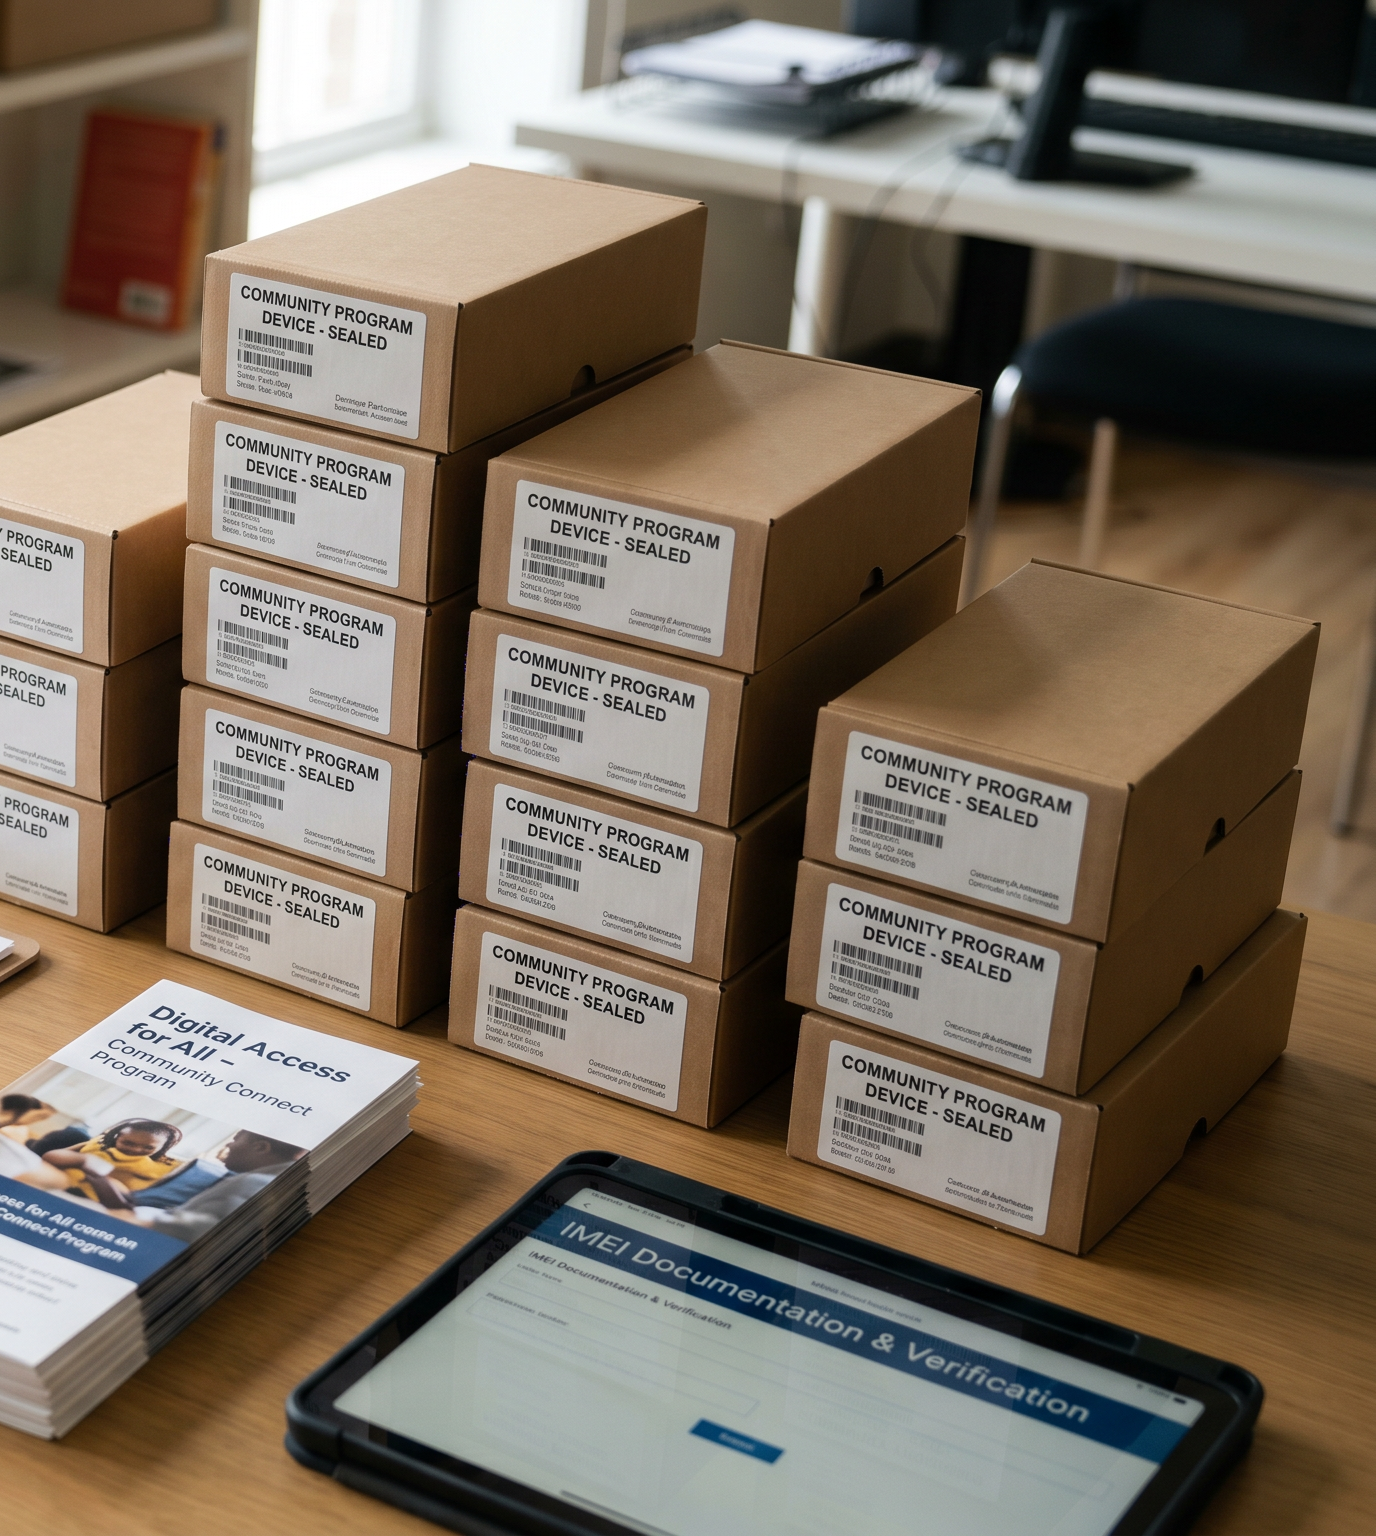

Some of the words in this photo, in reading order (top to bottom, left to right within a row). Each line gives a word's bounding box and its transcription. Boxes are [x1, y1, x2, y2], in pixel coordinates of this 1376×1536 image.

[240, 285, 331, 317] COMMUNITY
[334, 304, 413, 336] PROGRAM
[262, 310, 316, 335] DEVICE
[327, 325, 388, 351] SEALED
[225, 433, 313, 466] COMMUNITY
[316, 455, 392, 487] PROGRAM
[246, 458, 298, 484] DEVICE
[309, 474, 367, 501] SEALED
[6, 529, 74, 560] PROGRAM
[527, 493, 629, 528] COMMUNITY
[632, 516, 720, 550] PROGRAM
[550, 519, 611, 546] DEVICE
[624, 536, 691, 564] SEALED
[0, 547, 53, 572] SEALED
[219, 579, 306, 614] COMMUNITY
[309, 603, 384, 637] PROGRAM
[240, 603, 291, 631] DEVICE
[302, 621, 359, 650] SEALED
[0, 664, 67, 696] PROGRAM
[508, 647, 607, 685] COMMUNITY
[610, 673, 695, 709] PROGRAM
[530, 673, 589, 702] DEVICE
[602, 693, 667, 722] SEALED
[215, 721, 302, 757] COMMUNITY
[305, 747, 379, 782] PROGRAM
[236, 745, 287, 772] DEVICE
[298, 764, 355, 793] SEALED
[861, 745, 972, 787] COMMUNITY
[976, 775, 1072, 816] PROGRAM
[884, 773, 951, 804] DEVICE
[965, 796, 1039, 828] SEALED
[4, 796, 69, 828] PROGRAM
[505, 797, 603, 836] COMMUNITY
[606, 825, 690, 862] PROGRAM
[527, 822, 585, 852] DEVICE
[597, 844, 662, 874] SEALED
[203, 855, 288, 892] COMMUNITY
[291, 882, 364, 919] PROGRAM
[224, 880, 274, 907] DEVICE
[284, 900, 340, 929] SEALED
[839, 897, 948, 941] COMMUNITY
[951, 930, 1045, 972] PROGRAM
[862, 925, 927, 957] DEVICE
[940, 949, 1012, 983] SEALED
[492, 945, 589, 986] COMMUNITY
[592, 976, 674, 1015] PROGRAM
[514, 971, 571, 1001] DEVICE
[582, 994, 645, 1025] SEALED
[127, 1023, 171, 1045] for
[170, 1041, 217, 1061] All
[149, 1006, 245, 1047] Digital
[242, 1042, 351, 1083] Access
[90, 1051, 177, 1089] Program
[108, 1039, 223, 1087] Community
[226, 1082, 313, 1117] Connect
[841, 1054, 950, 1100] COMMUNITY
[953, 1089, 1046, 1133] PROGRAM
[865, 1082, 928, 1116] DEVICE
[942, 1108, 1013, 1143] SEALED
[25, 1204, 51, 1217] for
[50, 1214, 76, 1227] All
[56, 1232, 126, 1262] Program
[529, 1252, 557, 1265] IMEI
[558, 1262, 648, 1299] Documentation
[665, 1301, 732, 1329] Verification
[560, 1222, 630, 1256] IMEI
[630, 1247, 865, 1344] Documentation
[872, 1334, 895, 1353] &
[908, 1342, 1089, 1422] Verification
